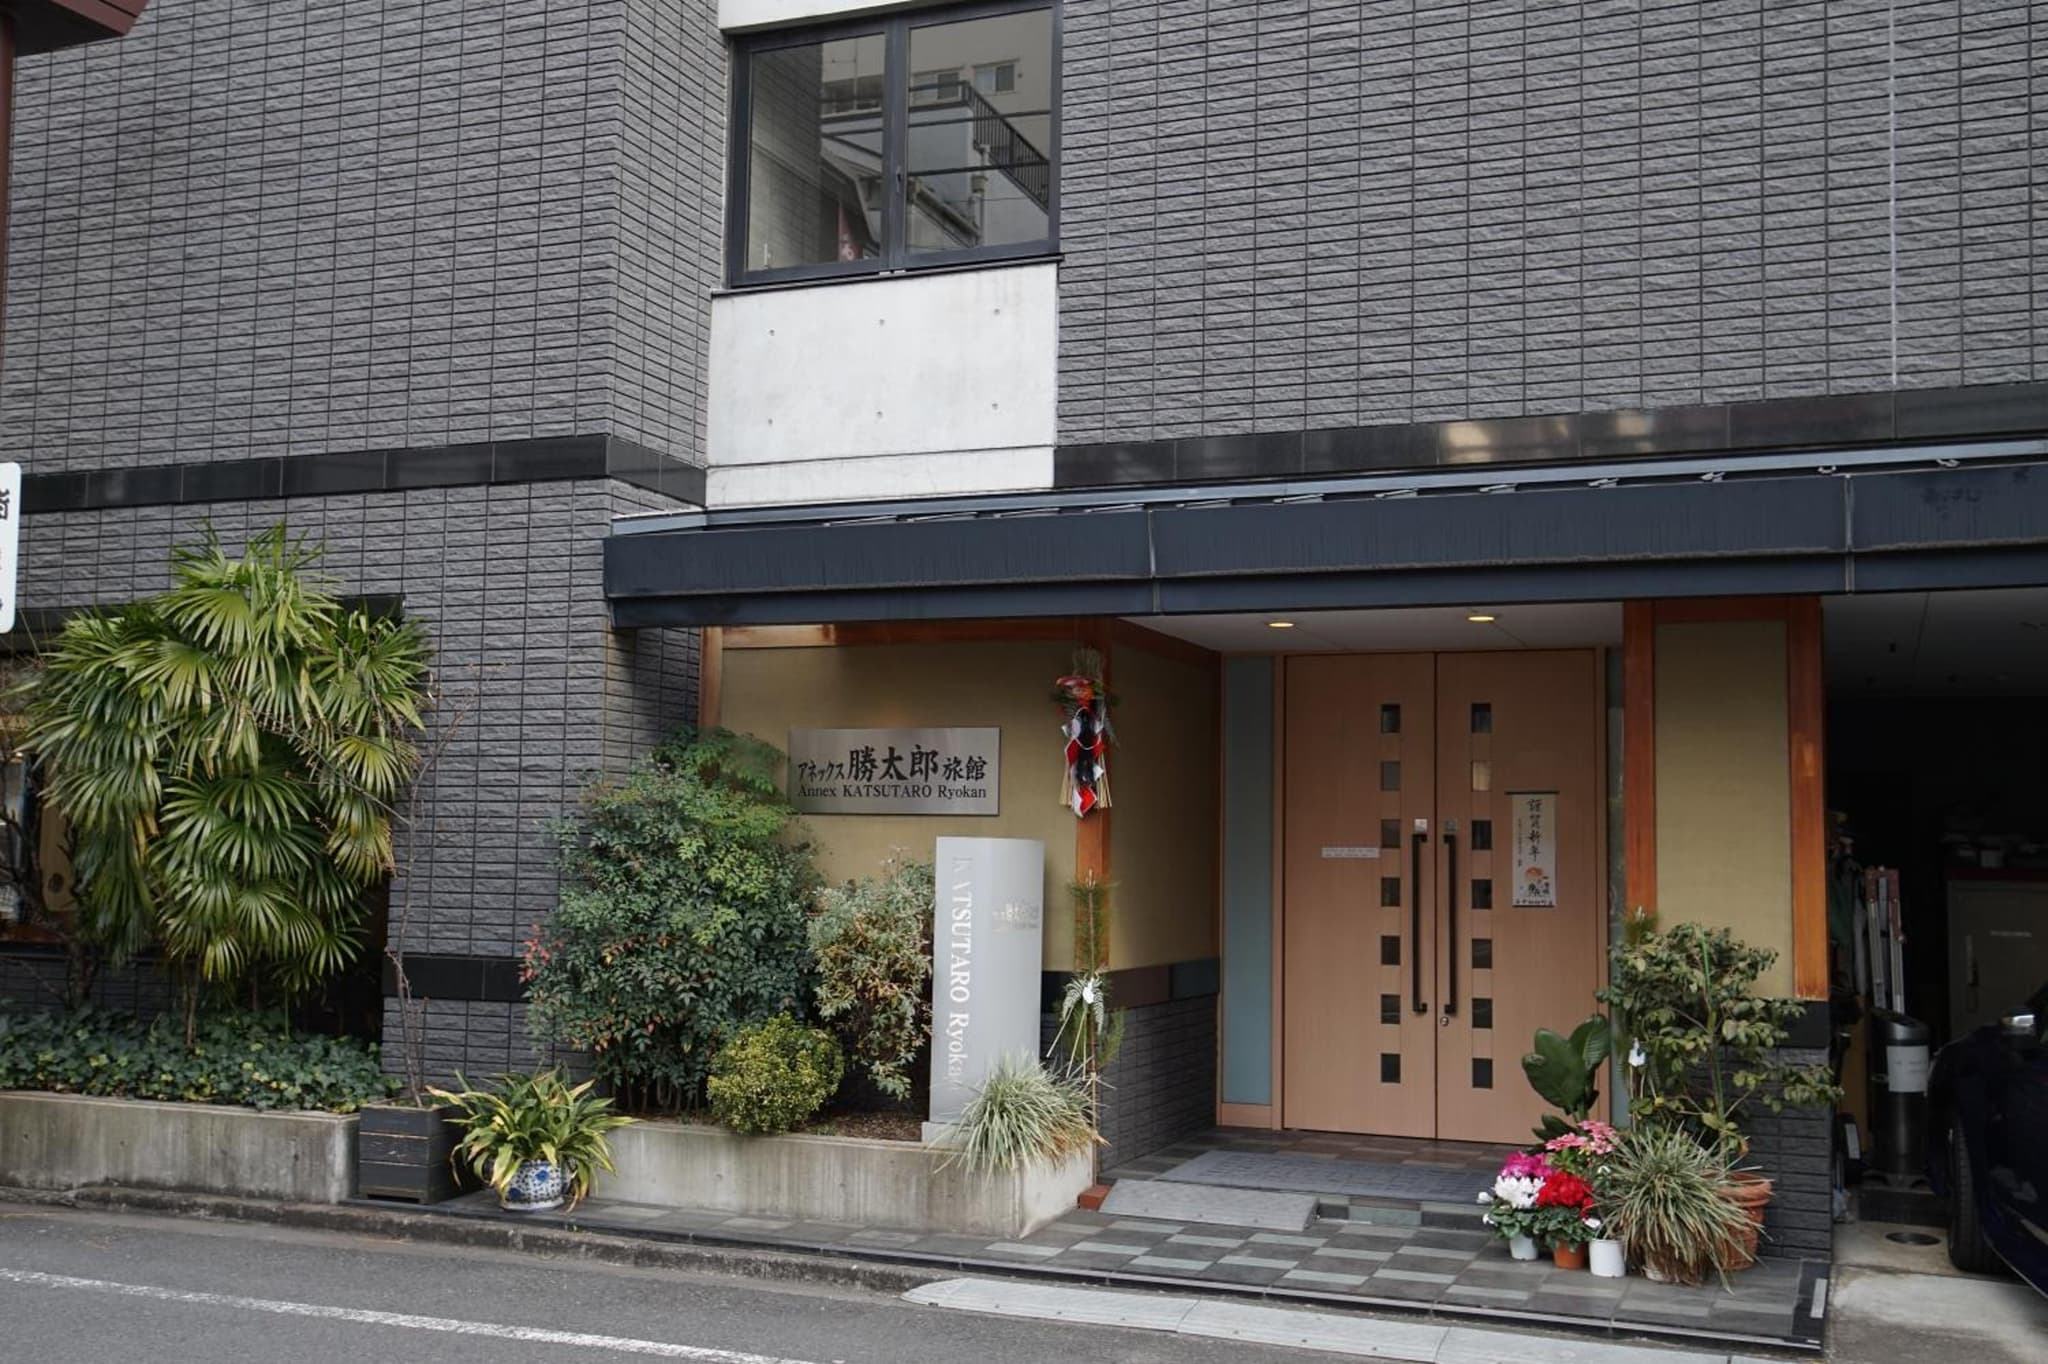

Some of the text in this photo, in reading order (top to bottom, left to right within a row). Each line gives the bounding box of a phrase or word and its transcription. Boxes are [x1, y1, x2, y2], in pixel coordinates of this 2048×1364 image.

[798, 784, 987, 800] Annex KATSUTARO Ryokan
